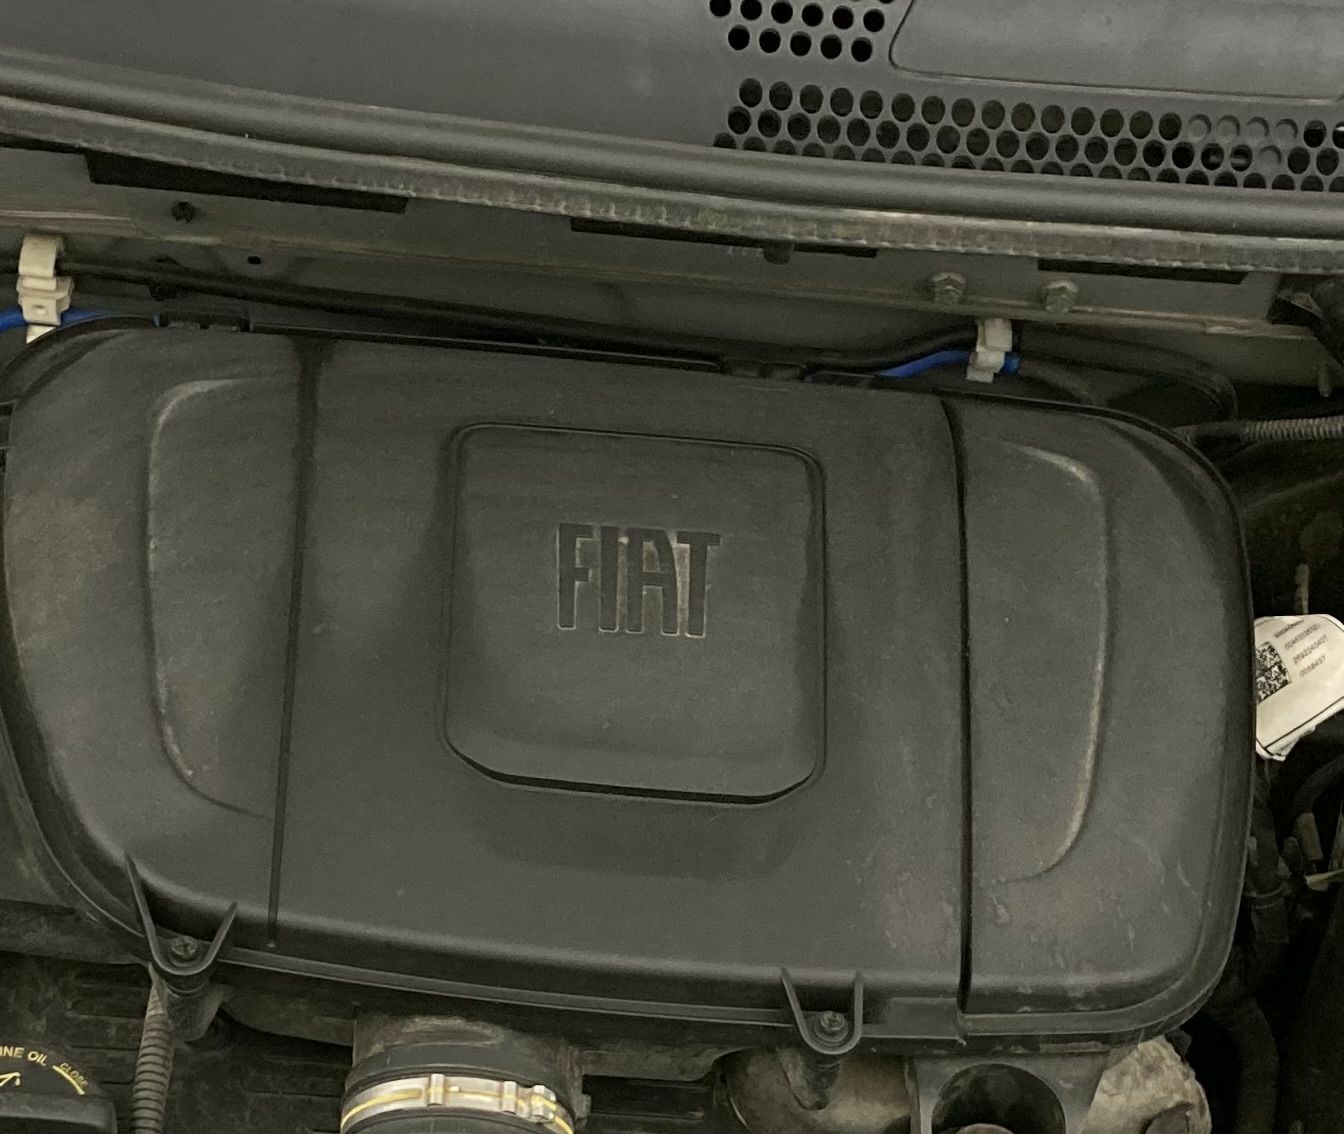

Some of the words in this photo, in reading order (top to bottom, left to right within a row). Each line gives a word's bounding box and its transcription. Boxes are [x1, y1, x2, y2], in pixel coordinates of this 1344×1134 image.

[556, 523, 722, 639] FIAT
[27, 1050, 49, 1067] OIL
[59, 1062, 89, 1086] CLOSE
